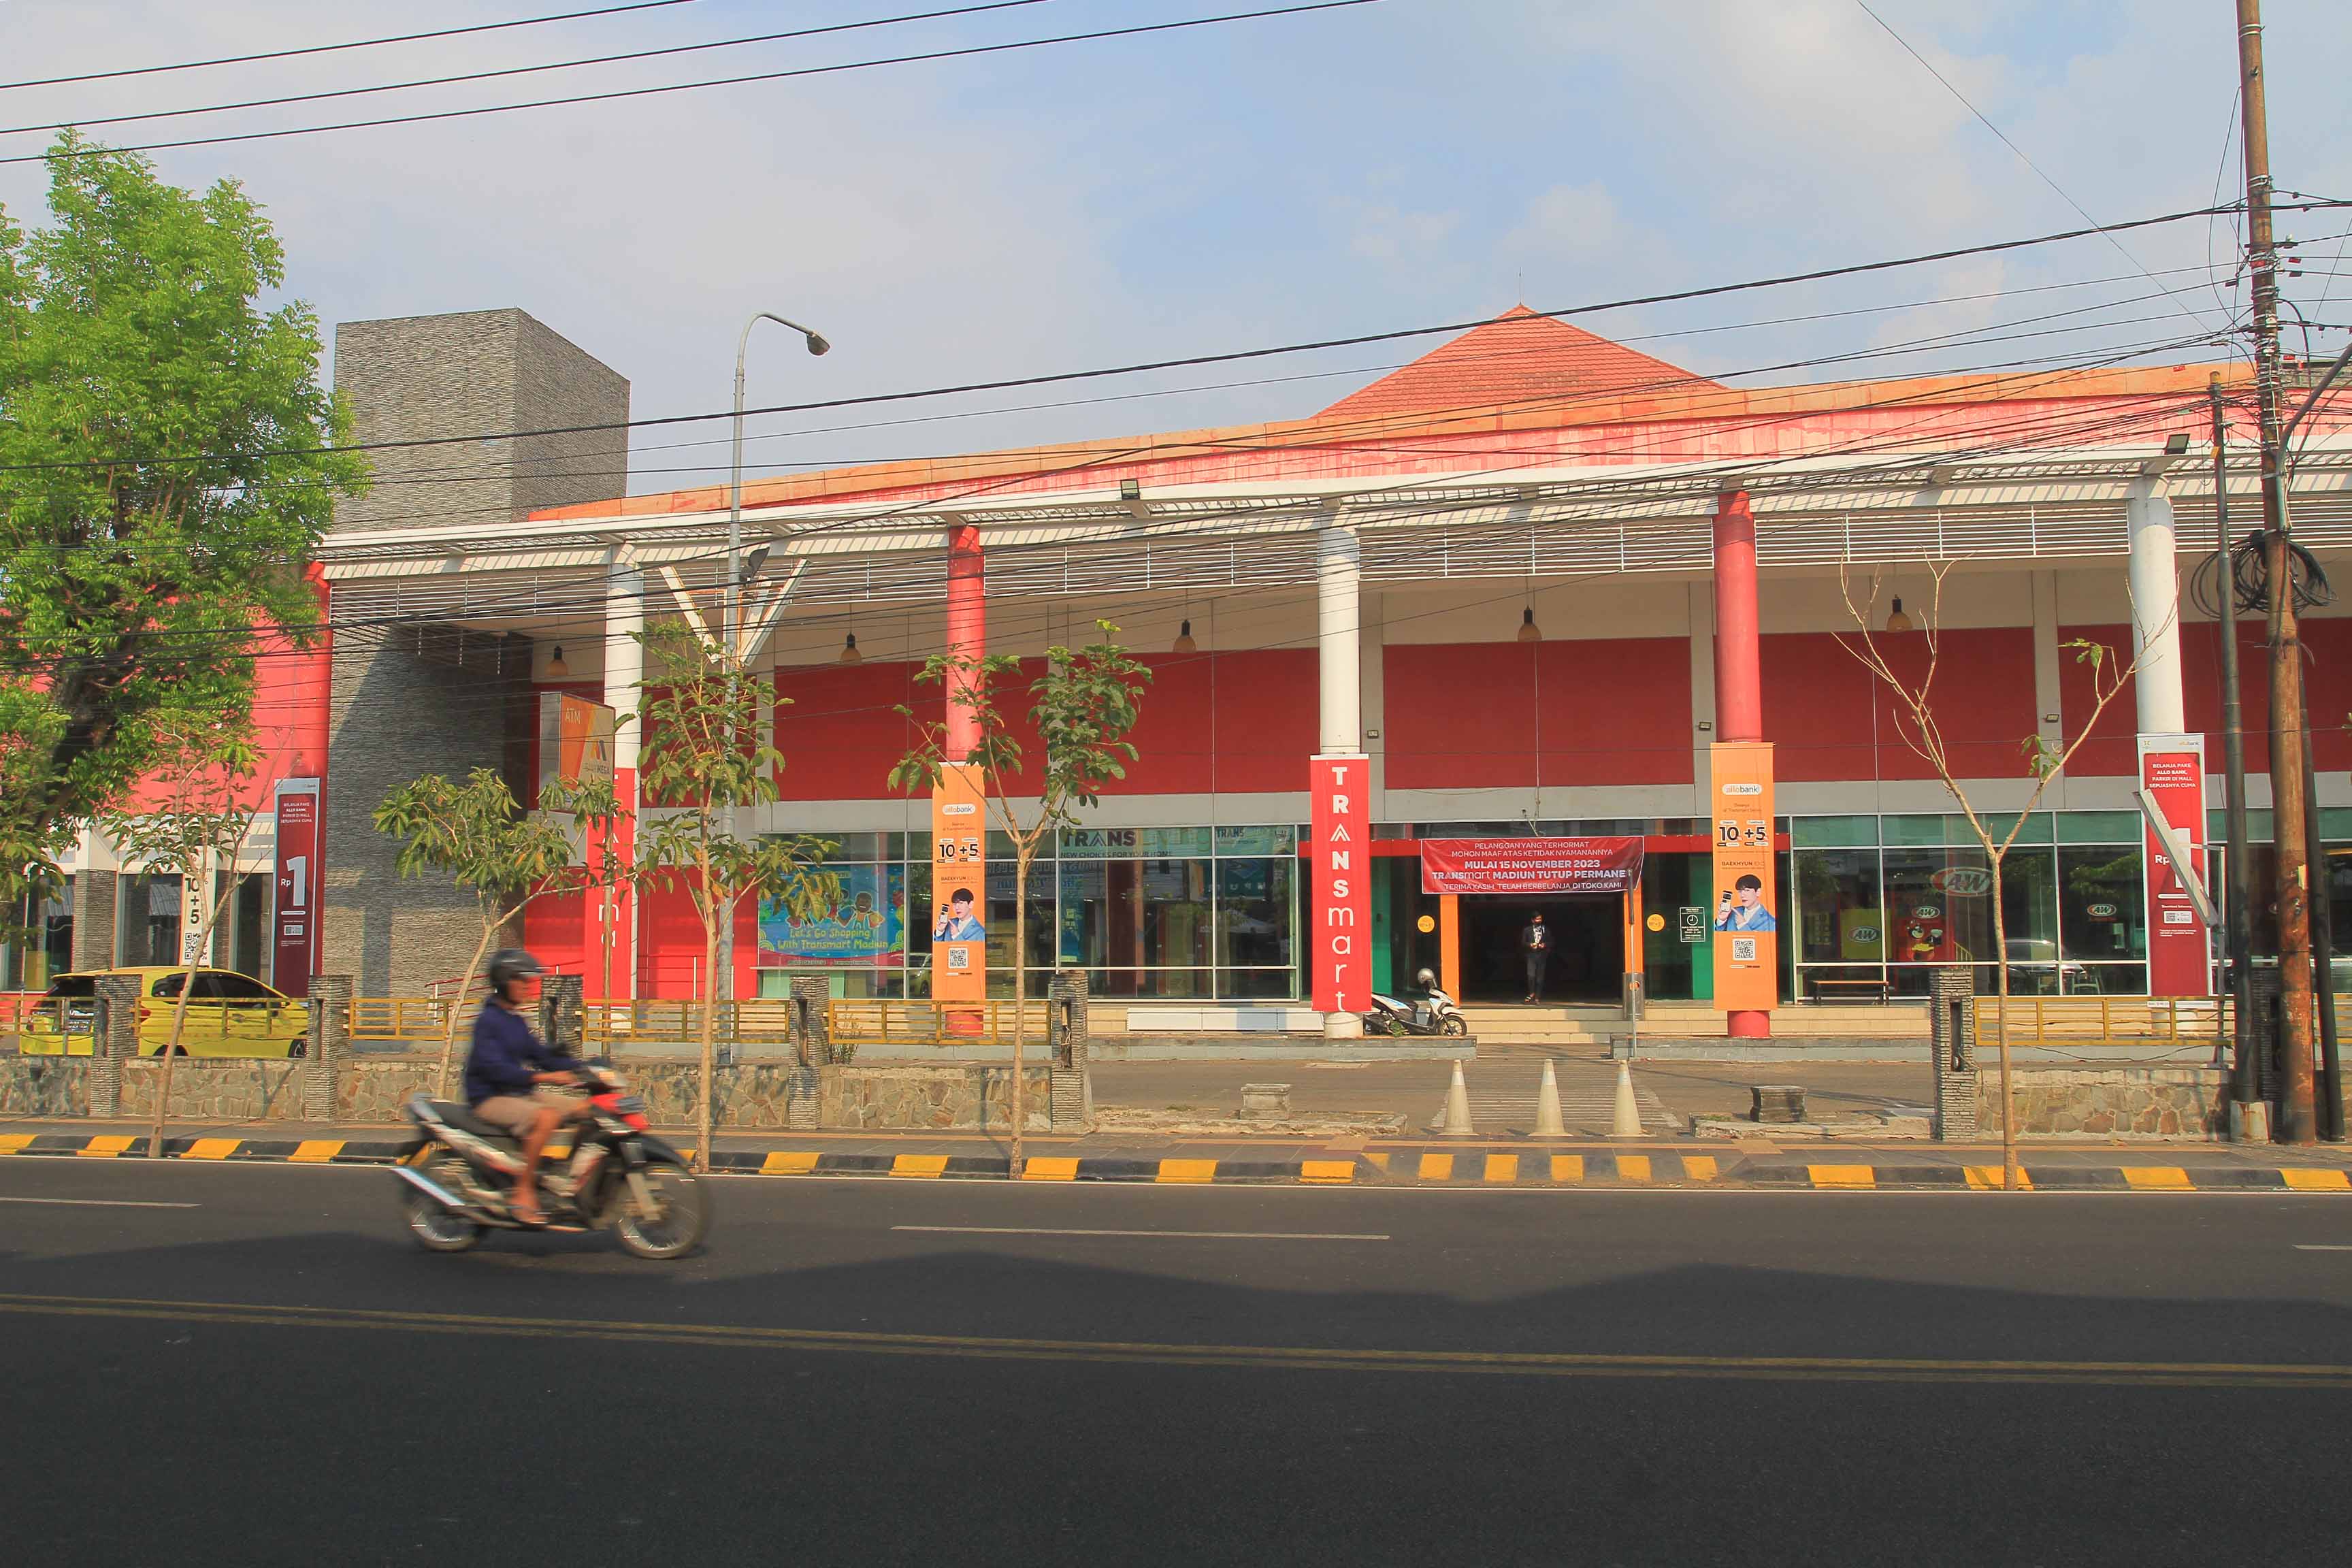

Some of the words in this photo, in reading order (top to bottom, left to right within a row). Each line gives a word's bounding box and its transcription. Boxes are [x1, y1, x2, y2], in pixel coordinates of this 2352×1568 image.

[565, 706, 581, 725] ATM
[1512, 860, 1571, 869] NOVEMBER
[1573, 860, 1601, 868] 2023
[280, 879, 291, 887] Rp
[286, 855, 306, 906] 1
[1432, 871, 1490, 879] TRANSmart
[1492, 871, 1535, 879] MADIUN
[1537, 870, 1573, 879] TUTUP
